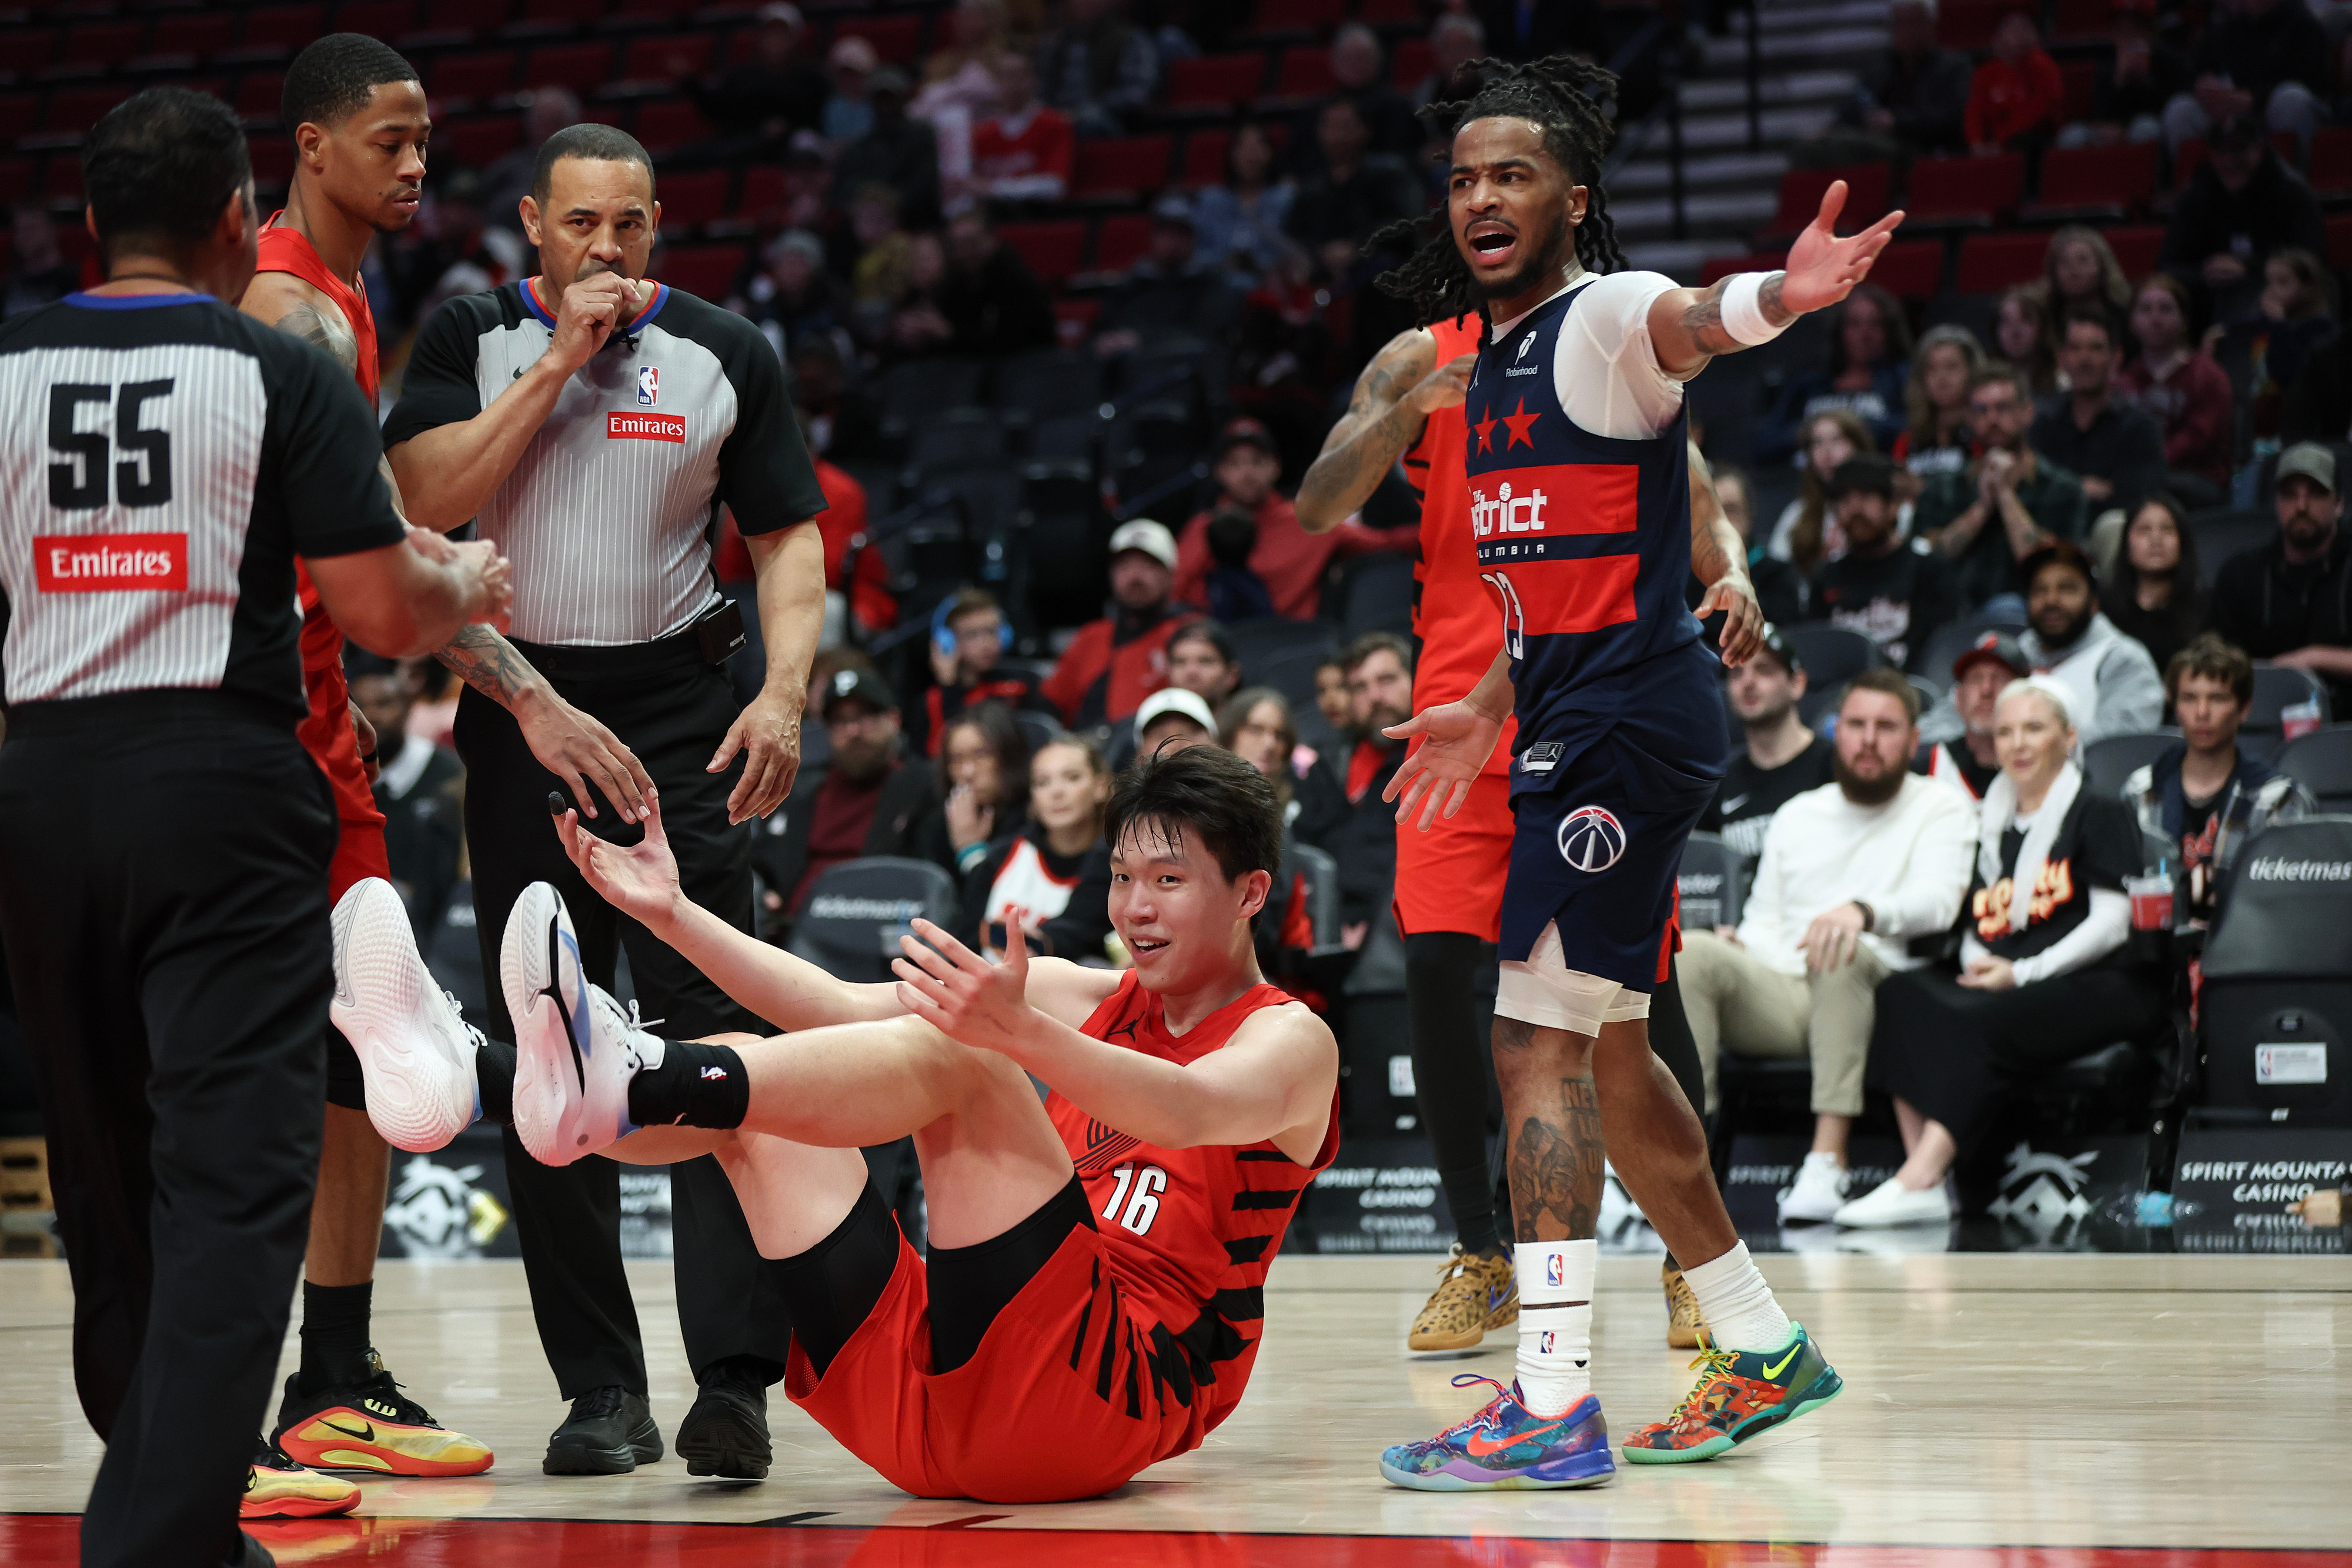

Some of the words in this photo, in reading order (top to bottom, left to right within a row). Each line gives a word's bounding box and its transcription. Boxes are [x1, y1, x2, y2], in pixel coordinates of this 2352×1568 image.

[1505, 365, 1538, 377] Robinhood
[639, 396, 650, 404] NBA
[610, 417, 684, 436] Emirates
[49, 377, 175, 511] 55
[1471, 482, 1548, 540] strict
[1476, 544, 1545, 559] LUMBIA
[51, 547, 172, 579] Emirates
[2249, 857, 2352, 881] ticketmas
[2180, 1161, 2249, 1181] SPIRIT
[2250, 1161, 2352, 1181] MOUNTA
[1101, 1161, 1167, 1236] 16
[2233, 1183, 2315, 1202] CASINO
